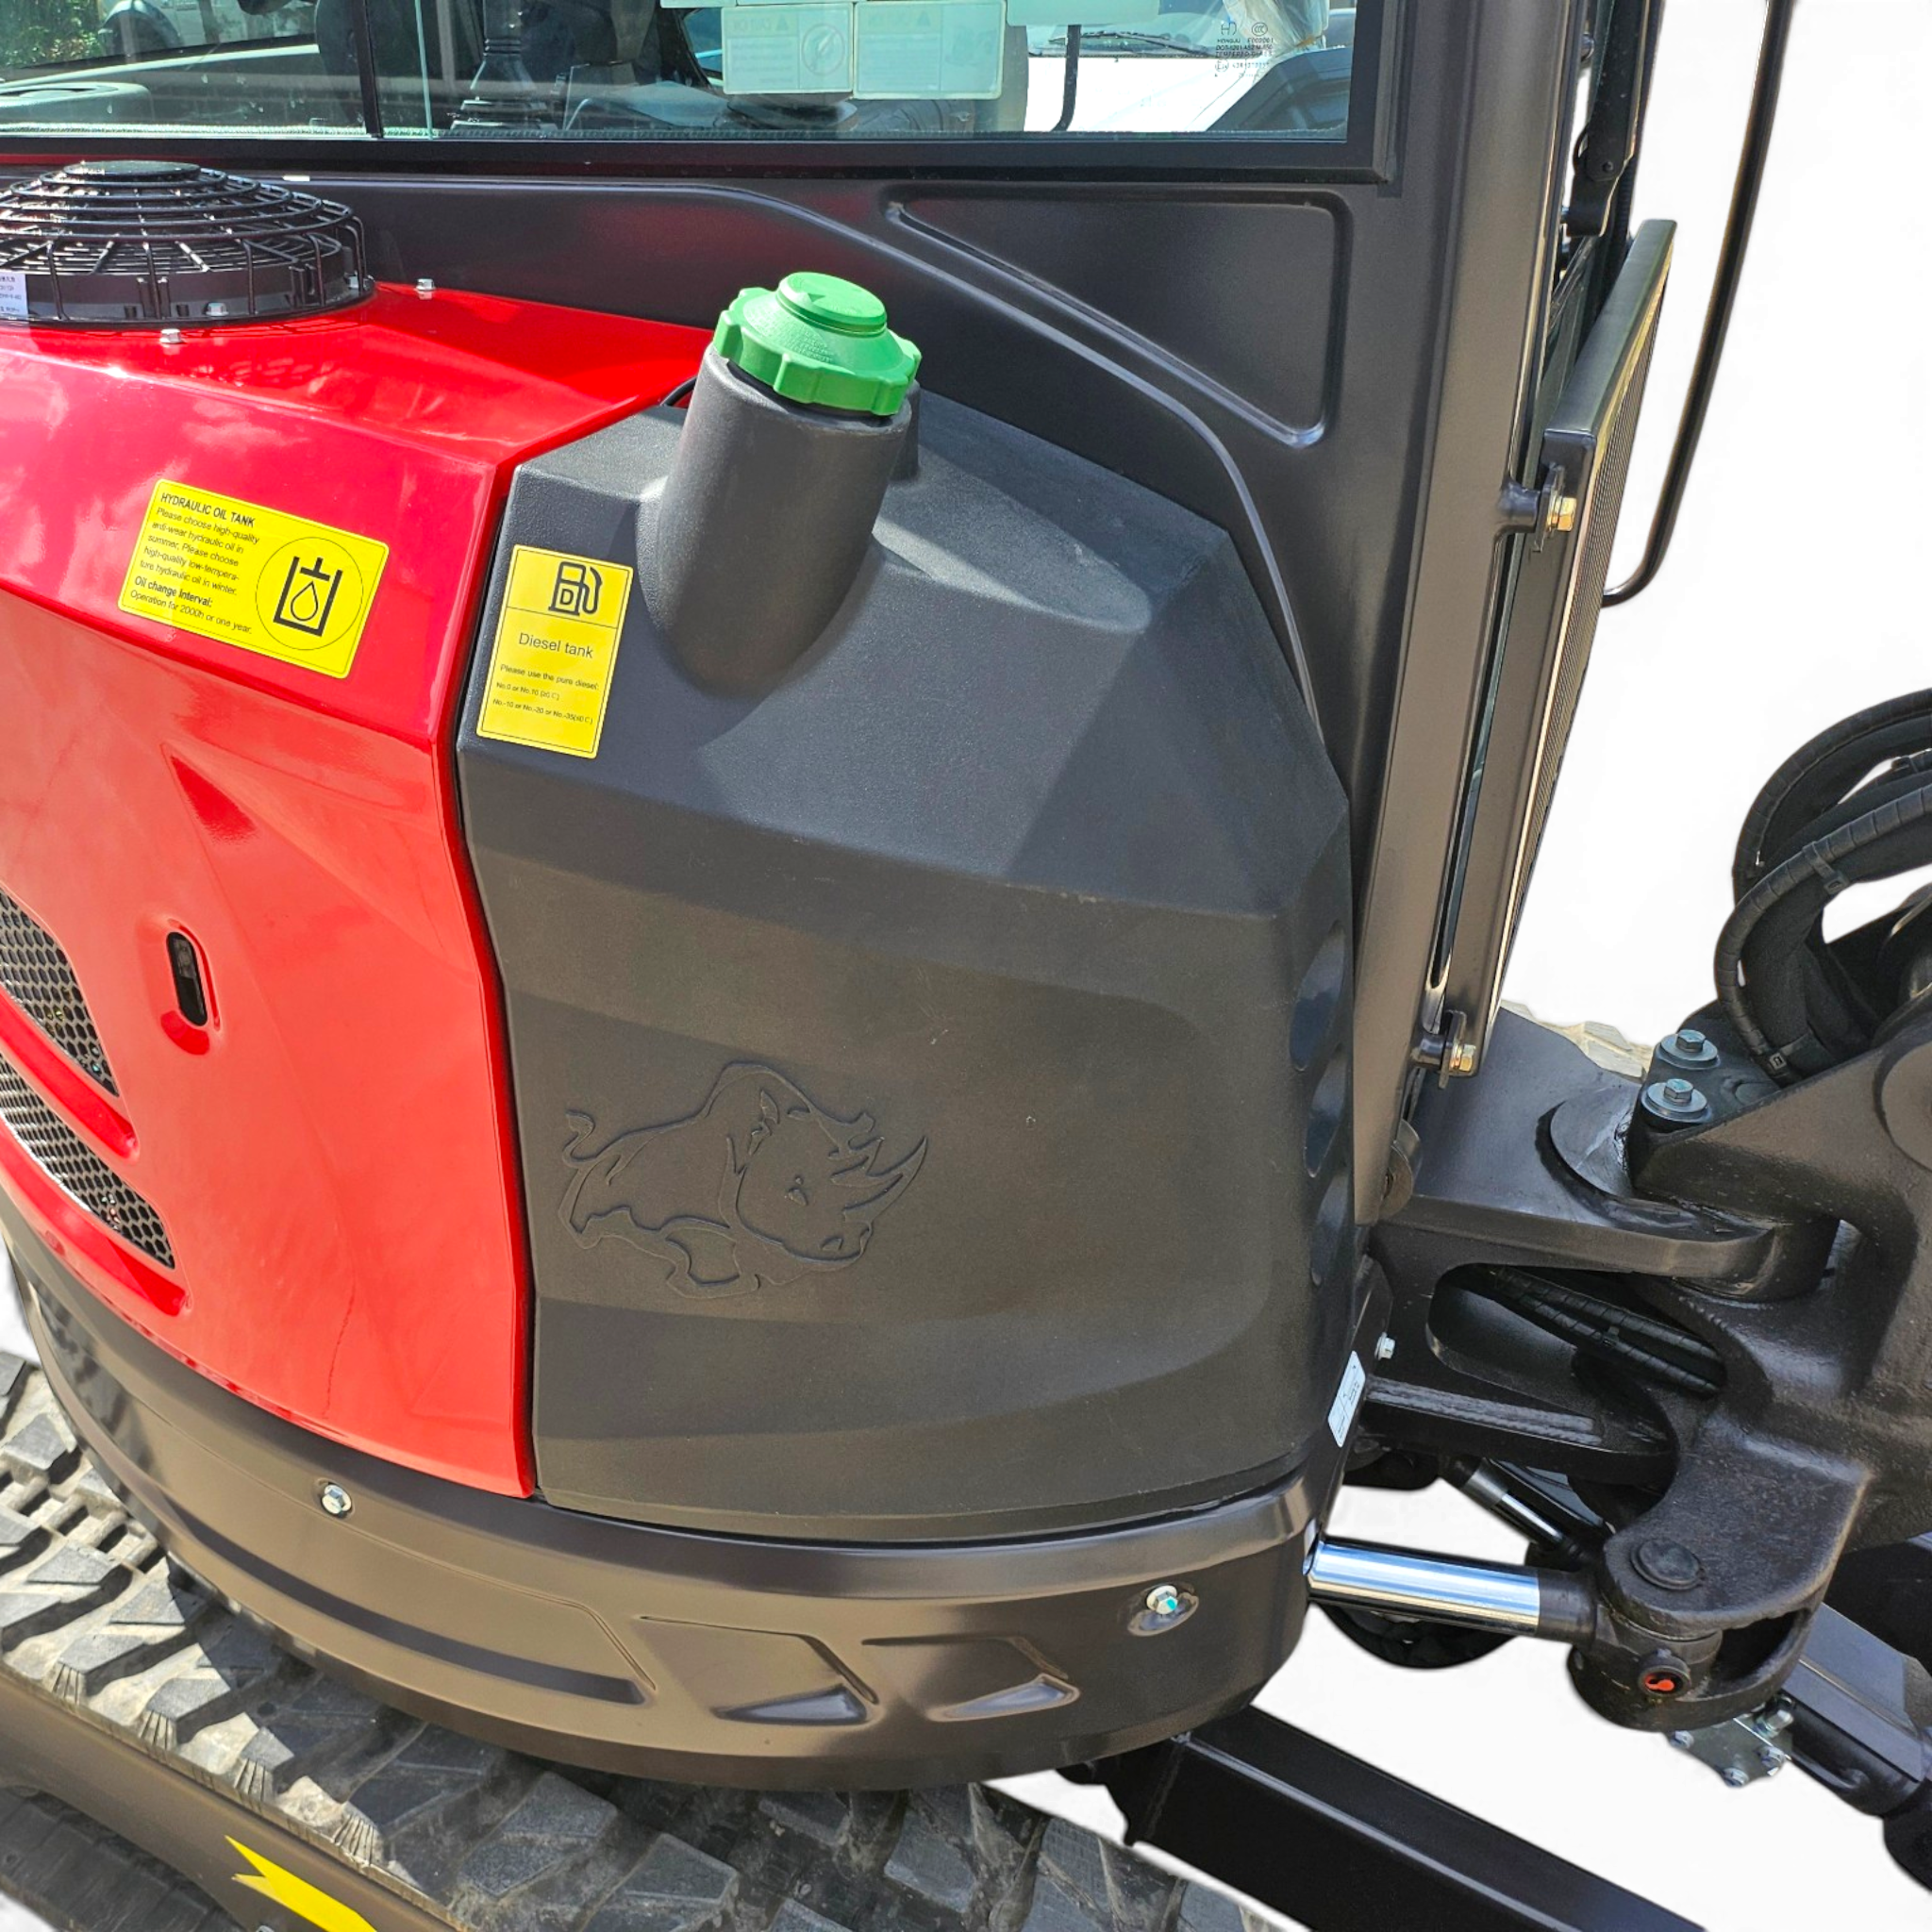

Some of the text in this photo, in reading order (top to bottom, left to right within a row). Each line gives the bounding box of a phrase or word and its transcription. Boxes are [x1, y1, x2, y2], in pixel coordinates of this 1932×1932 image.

[157, 507, 259, 544] Please choose high-quality
[160, 492, 256, 527] HYDRAULIC OIL TANK
[152, 522, 244, 554] anti-wear hydraulic oil in
[181, 542, 208, 558] Please
[209, 552, 239, 566] choose
[143, 545, 240, 581] high-quality low-tempera-
[156, 564, 191, 582] hydraulic
[192, 575, 202, 584] oil
[203, 578, 210, 587] in
[135, 575, 213, 608] Oil change Interval:
[130, 590, 167, 608] Operation
[168, 600, 178, 610] for
[180, 605, 205, 620] 2000h
[216, 617, 231, 627] one
[519, 632, 593, 658] Diesel tank
[500, 663, 525, 676] Please
[527, 670, 541, 678] use
[542, 673, 555, 681] the
[556, 676, 574, 686] pure
